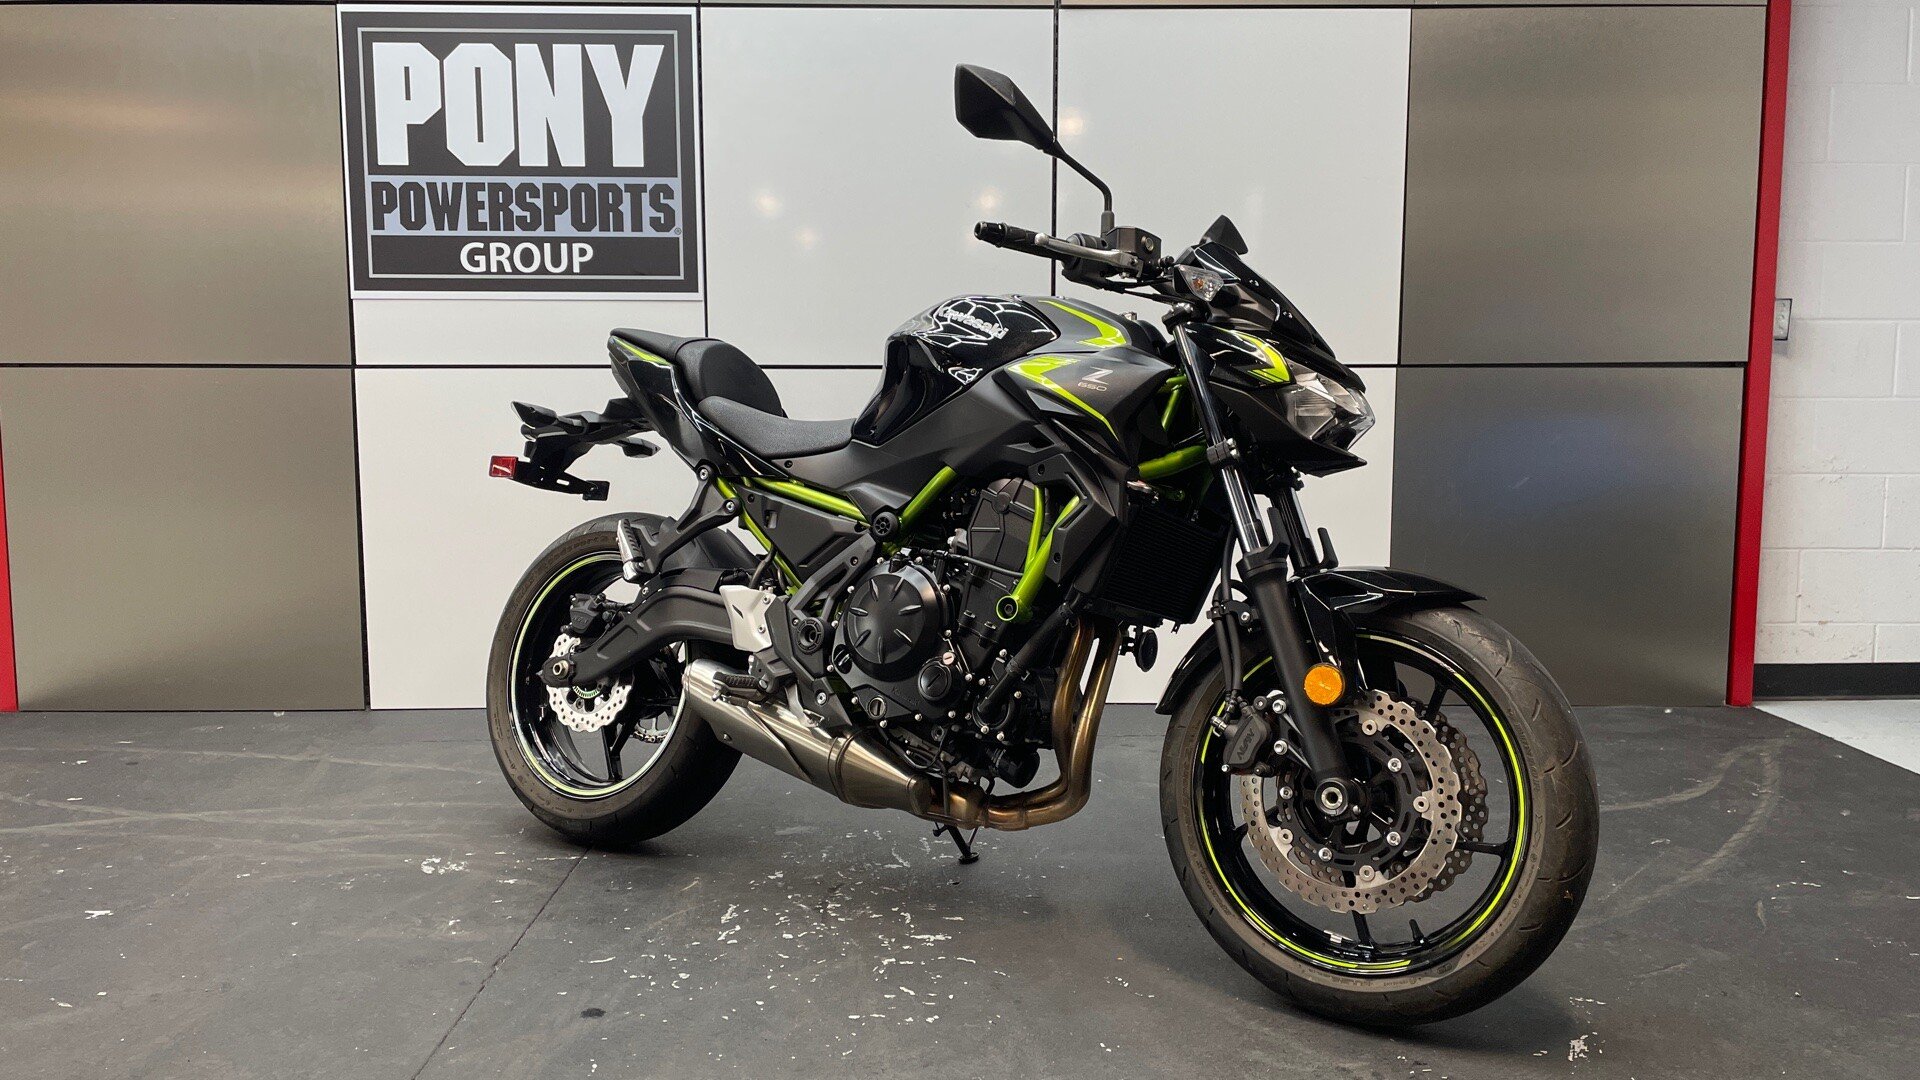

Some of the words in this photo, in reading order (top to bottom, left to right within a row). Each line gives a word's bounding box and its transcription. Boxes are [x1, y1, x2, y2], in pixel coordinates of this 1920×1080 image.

[372, 42, 665, 168] PONY
[371, 181, 676, 233] POWERSPORTS
[460, 242, 594, 273] GROUP
[1077, 382, 1107, 392] 650
[1081, 366, 1114, 385] Z
